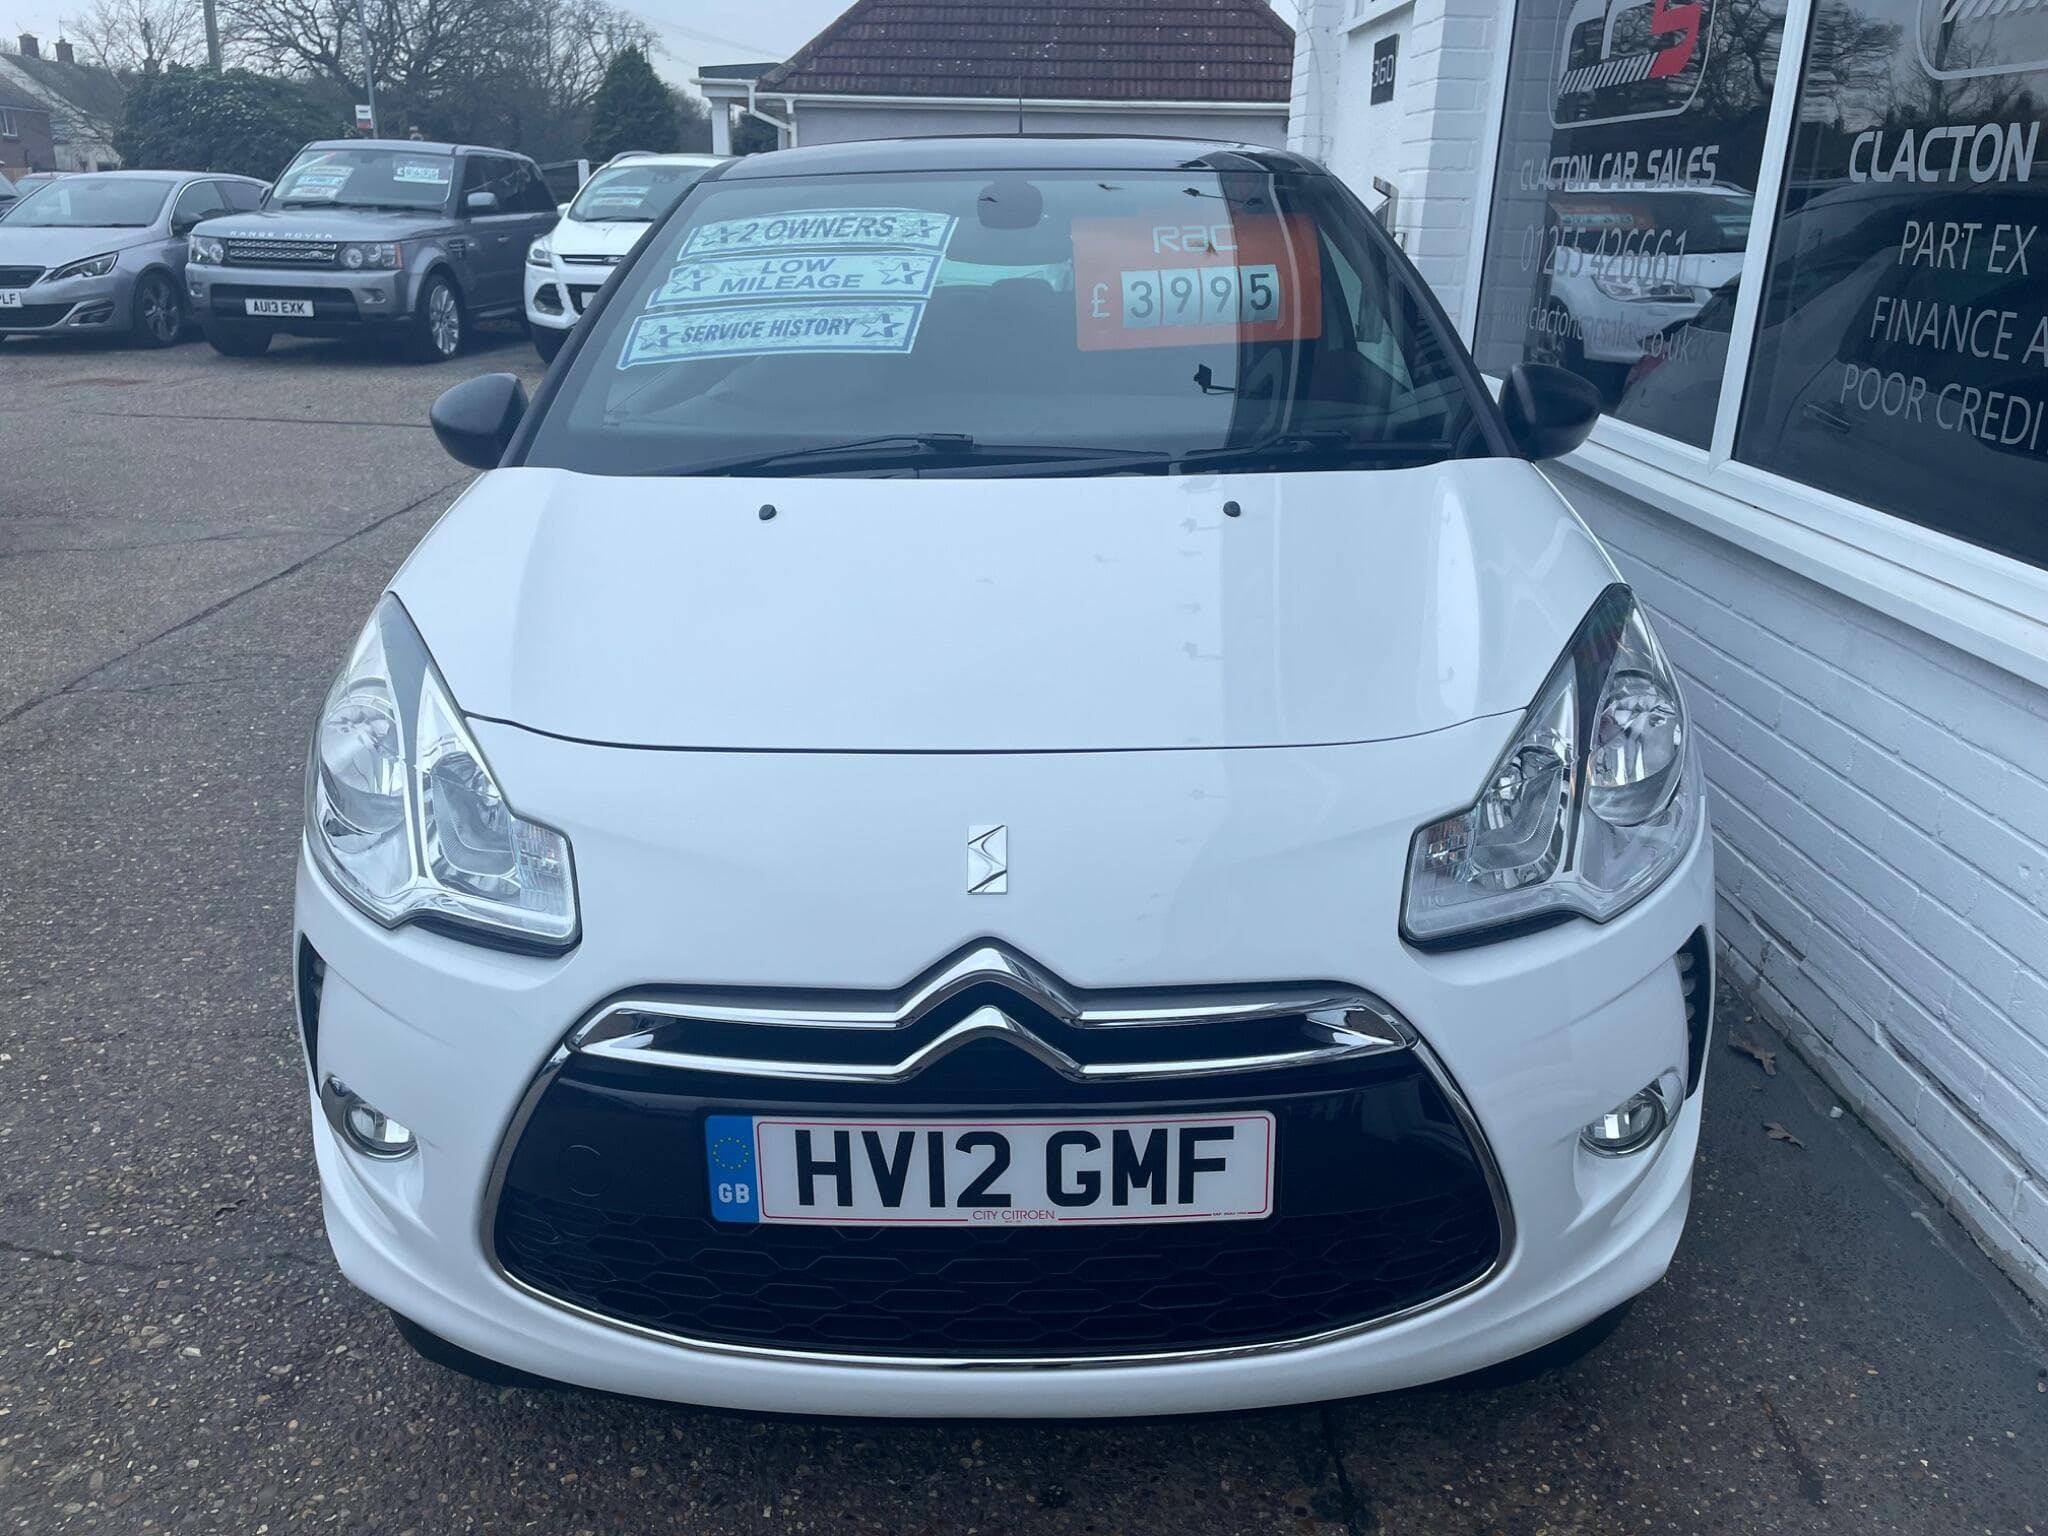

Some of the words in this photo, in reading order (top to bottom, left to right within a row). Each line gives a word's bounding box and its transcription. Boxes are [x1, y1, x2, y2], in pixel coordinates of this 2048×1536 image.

[1373, 54, 1395, 87] 360
[1521, 155, 1593, 191] CLACTON
[1600, 151, 1638, 187] CAR
[1647, 145, 1719, 186] SALES
[1849, 121, 2041, 183] CLACTON
[739, 222, 760, 241] 2
[765, 216, 898, 241] OWNERS
[1521, 224, 1587, 278] 01255
[1590, 227, 1688, 293] 426661
[1899, 220, 1983, 270] PART
[1987, 224, 2038, 275] EX
[761, 258, 835, 274] LOW
[719, 274, 865, 292] MILEAGE
[253, 301, 279, 313] AU13
[281, 302, 305, 314] EXK
[680, 321, 763, 344] SERVICE
[769, 318, 857, 338] HISTORY
[1870, 296, 2018, 360] FINANCE
[1840, 363, 1927, 423] POOR
[1935, 383, 2048, 451] CREDI
[795, 1129, 1012, 1208] HV12
[1045, 1125, 1235, 1207] GMF
[718, 1182, 750, 1204] GB
[973, 1210, 998, 1220] CITY
[1001, 1209, 1055, 1220] CITROEN
